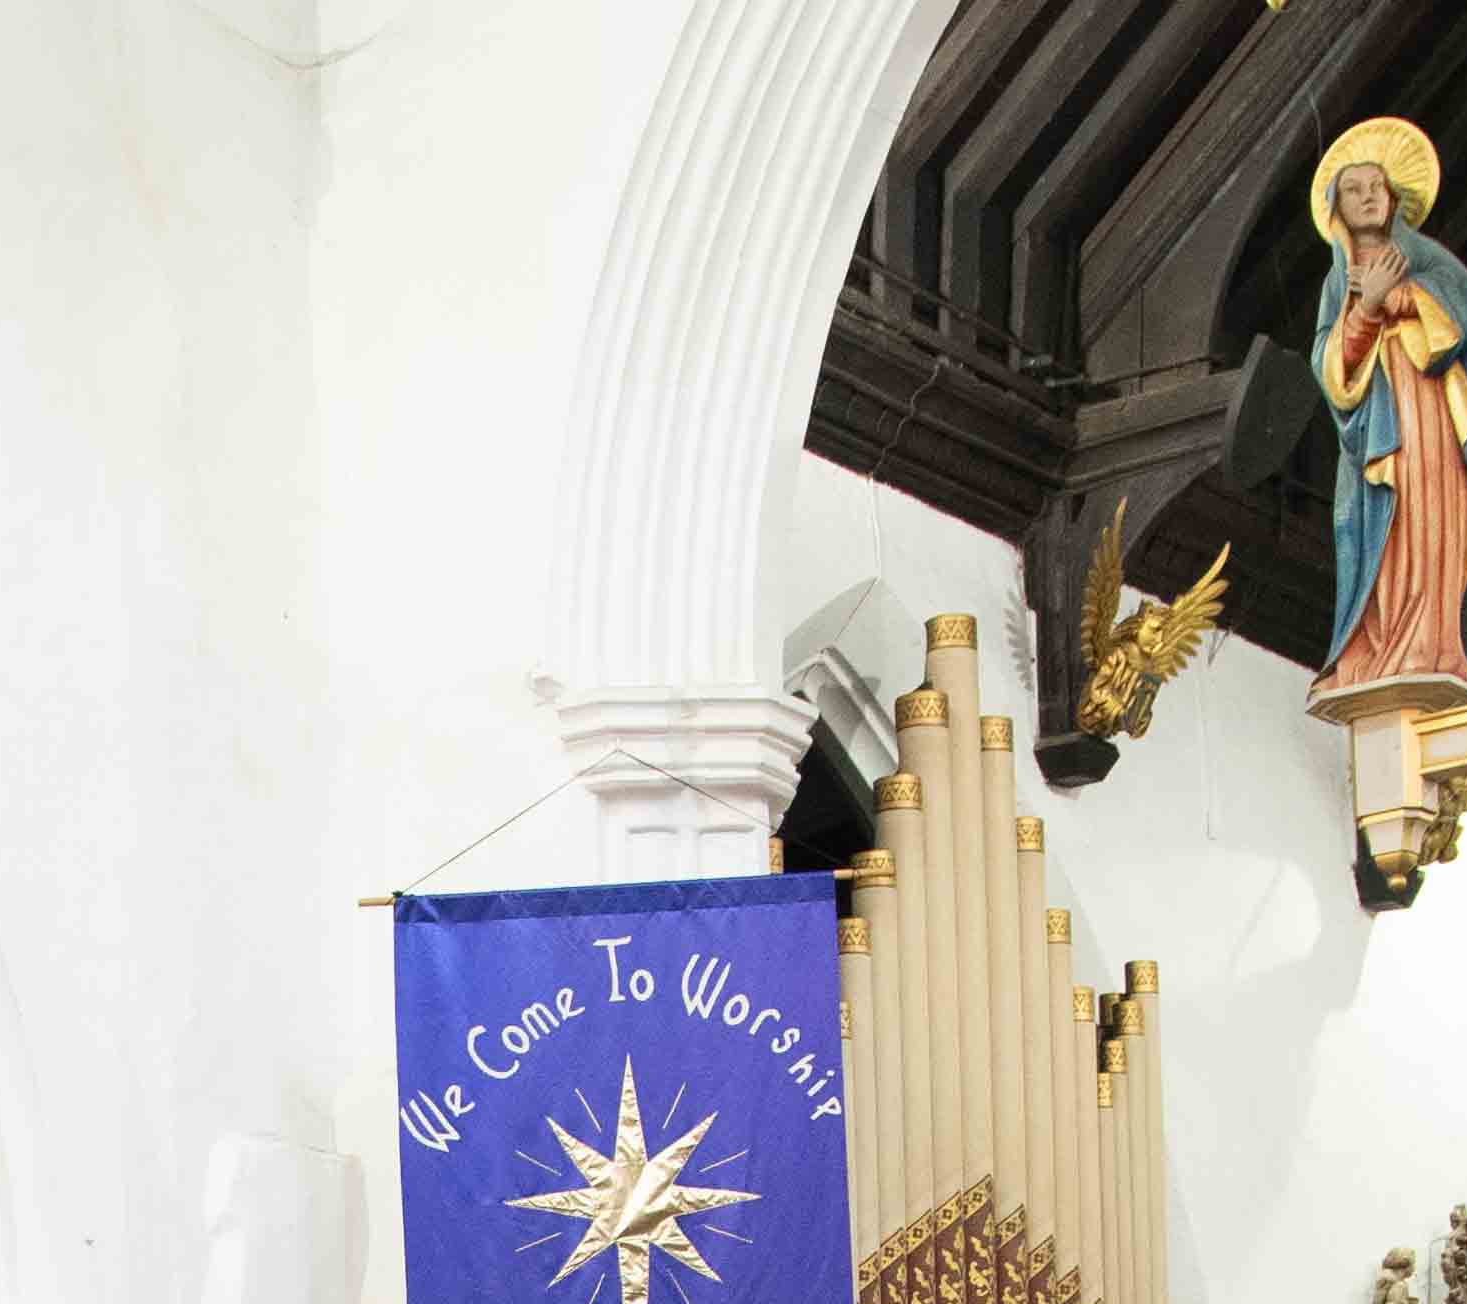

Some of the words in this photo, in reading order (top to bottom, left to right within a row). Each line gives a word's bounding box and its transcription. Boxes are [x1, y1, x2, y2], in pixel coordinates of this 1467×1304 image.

[399, 1085, 476, 1153] We
[467, 987, 586, 1080] Come
[593, 936, 655, 1004] To
[680, 952, 843, 1122] Worship
